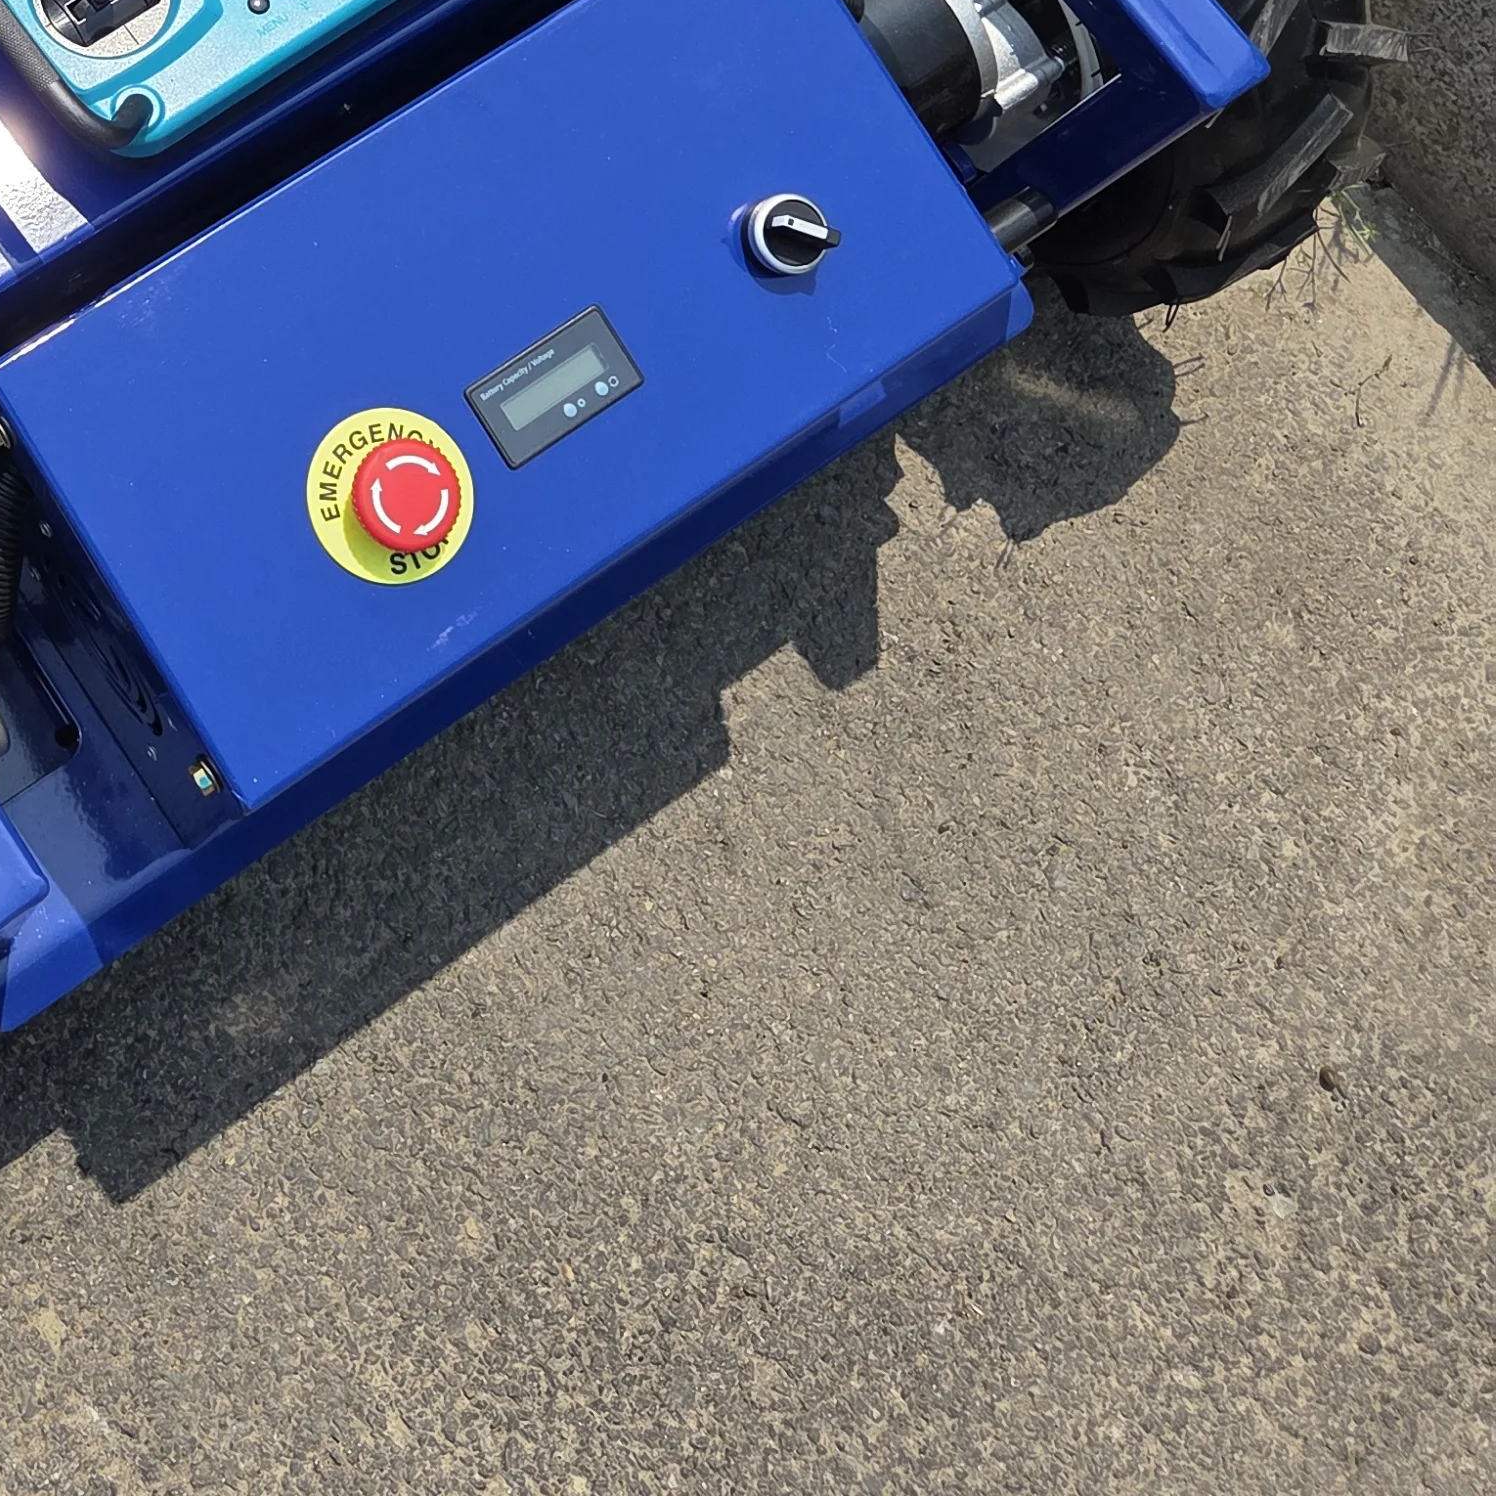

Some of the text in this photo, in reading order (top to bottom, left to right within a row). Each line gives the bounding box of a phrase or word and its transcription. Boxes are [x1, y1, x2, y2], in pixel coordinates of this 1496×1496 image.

[256, 13, 289, 37] MENU
[479, 382, 504, 401] Battery
[502, 365, 529, 386] Capacity
[530, 348, 555, 367] Voltage
[319, 422, 438, 521] EMERGEN
[389, 538, 449, 575] STO
